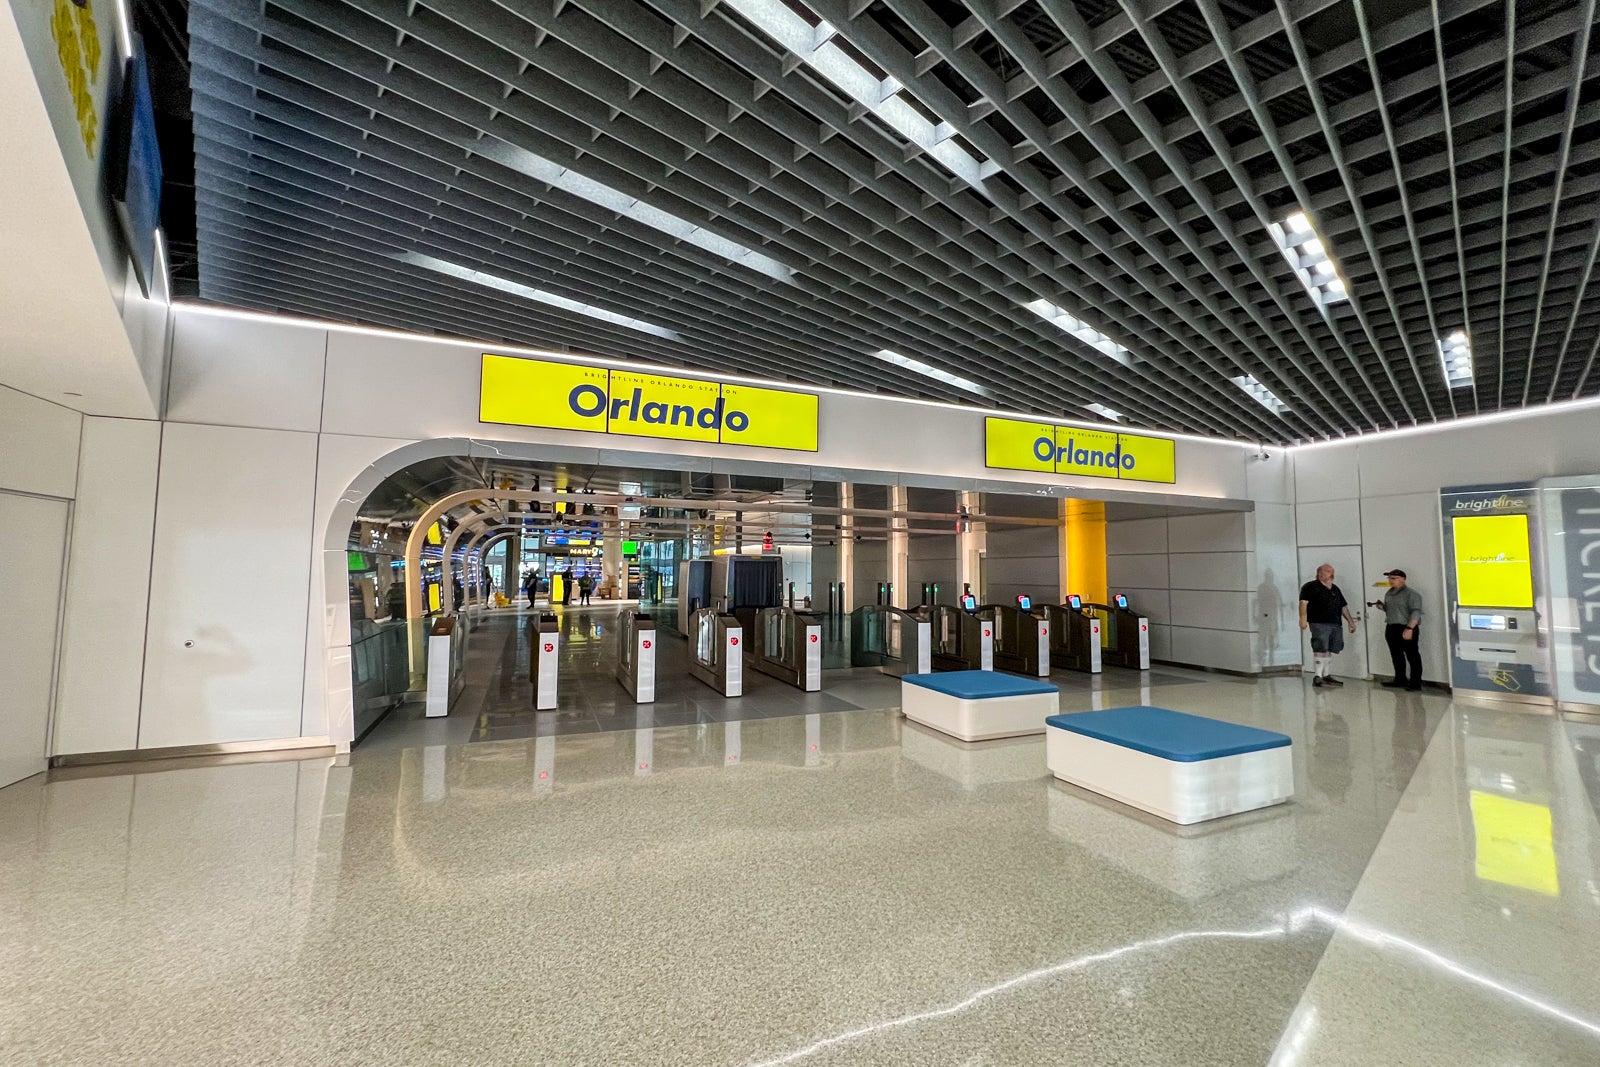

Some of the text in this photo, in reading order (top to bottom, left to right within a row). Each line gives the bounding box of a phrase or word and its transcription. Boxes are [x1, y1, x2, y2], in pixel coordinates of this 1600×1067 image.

[584, 372, 644, 383] BRIGHTLINE
[650, 380, 693, 389] ORLANDO
[568, 384, 749, 432] Orlando
[1033, 436, 1135, 470] Orlando
[1455, 494, 1524, 512] brightline
